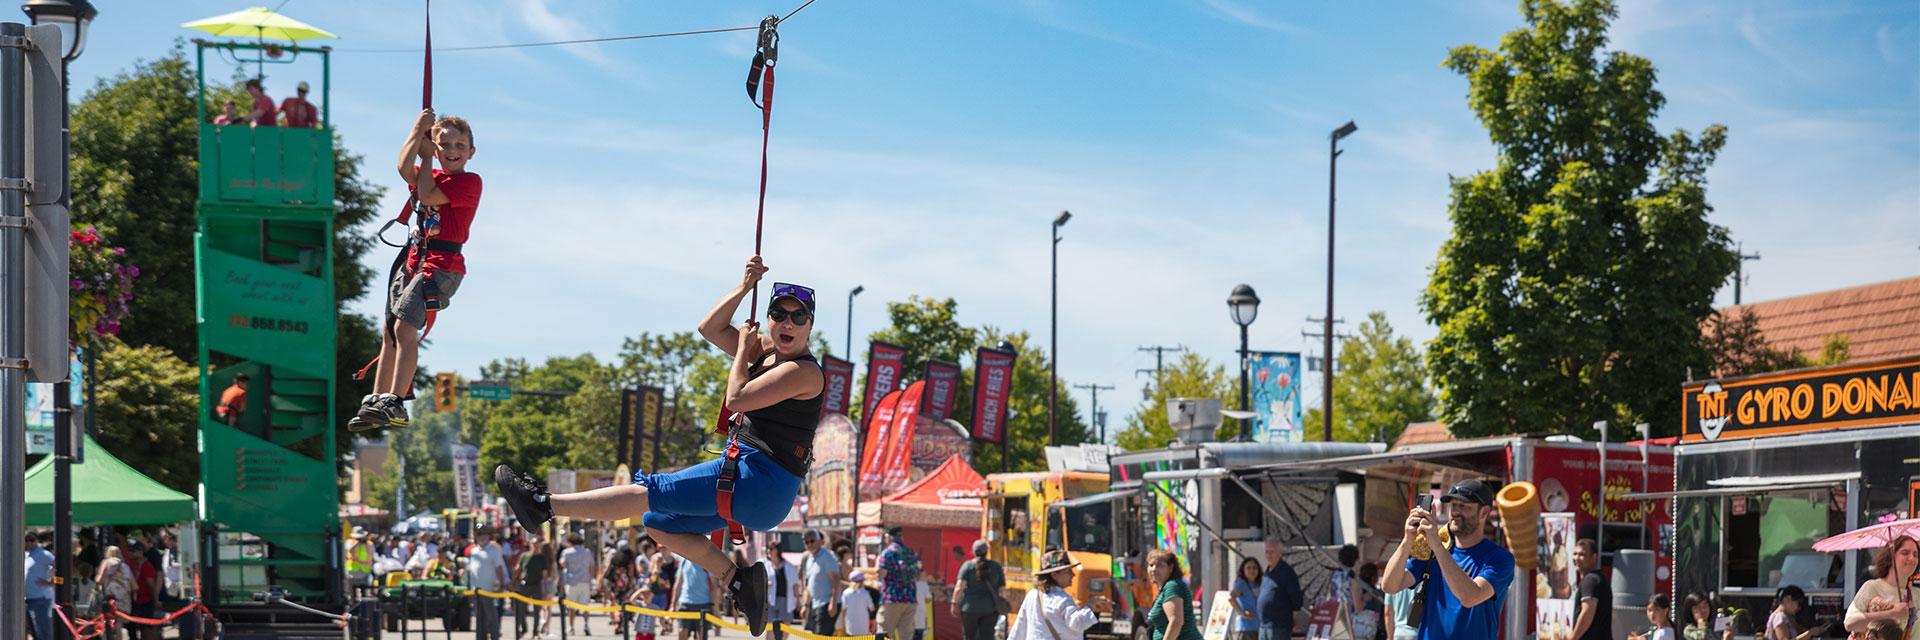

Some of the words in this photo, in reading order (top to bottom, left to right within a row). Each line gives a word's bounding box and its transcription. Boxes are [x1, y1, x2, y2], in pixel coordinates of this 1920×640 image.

[826, 375, 845, 411] DOGS
[987, 368, 1004, 397] FRIES
[982, 398, 999, 440] FRENCH
[1696, 390, 1728, 419] TNT
[1737, 383, 1815, 425] GYRO
